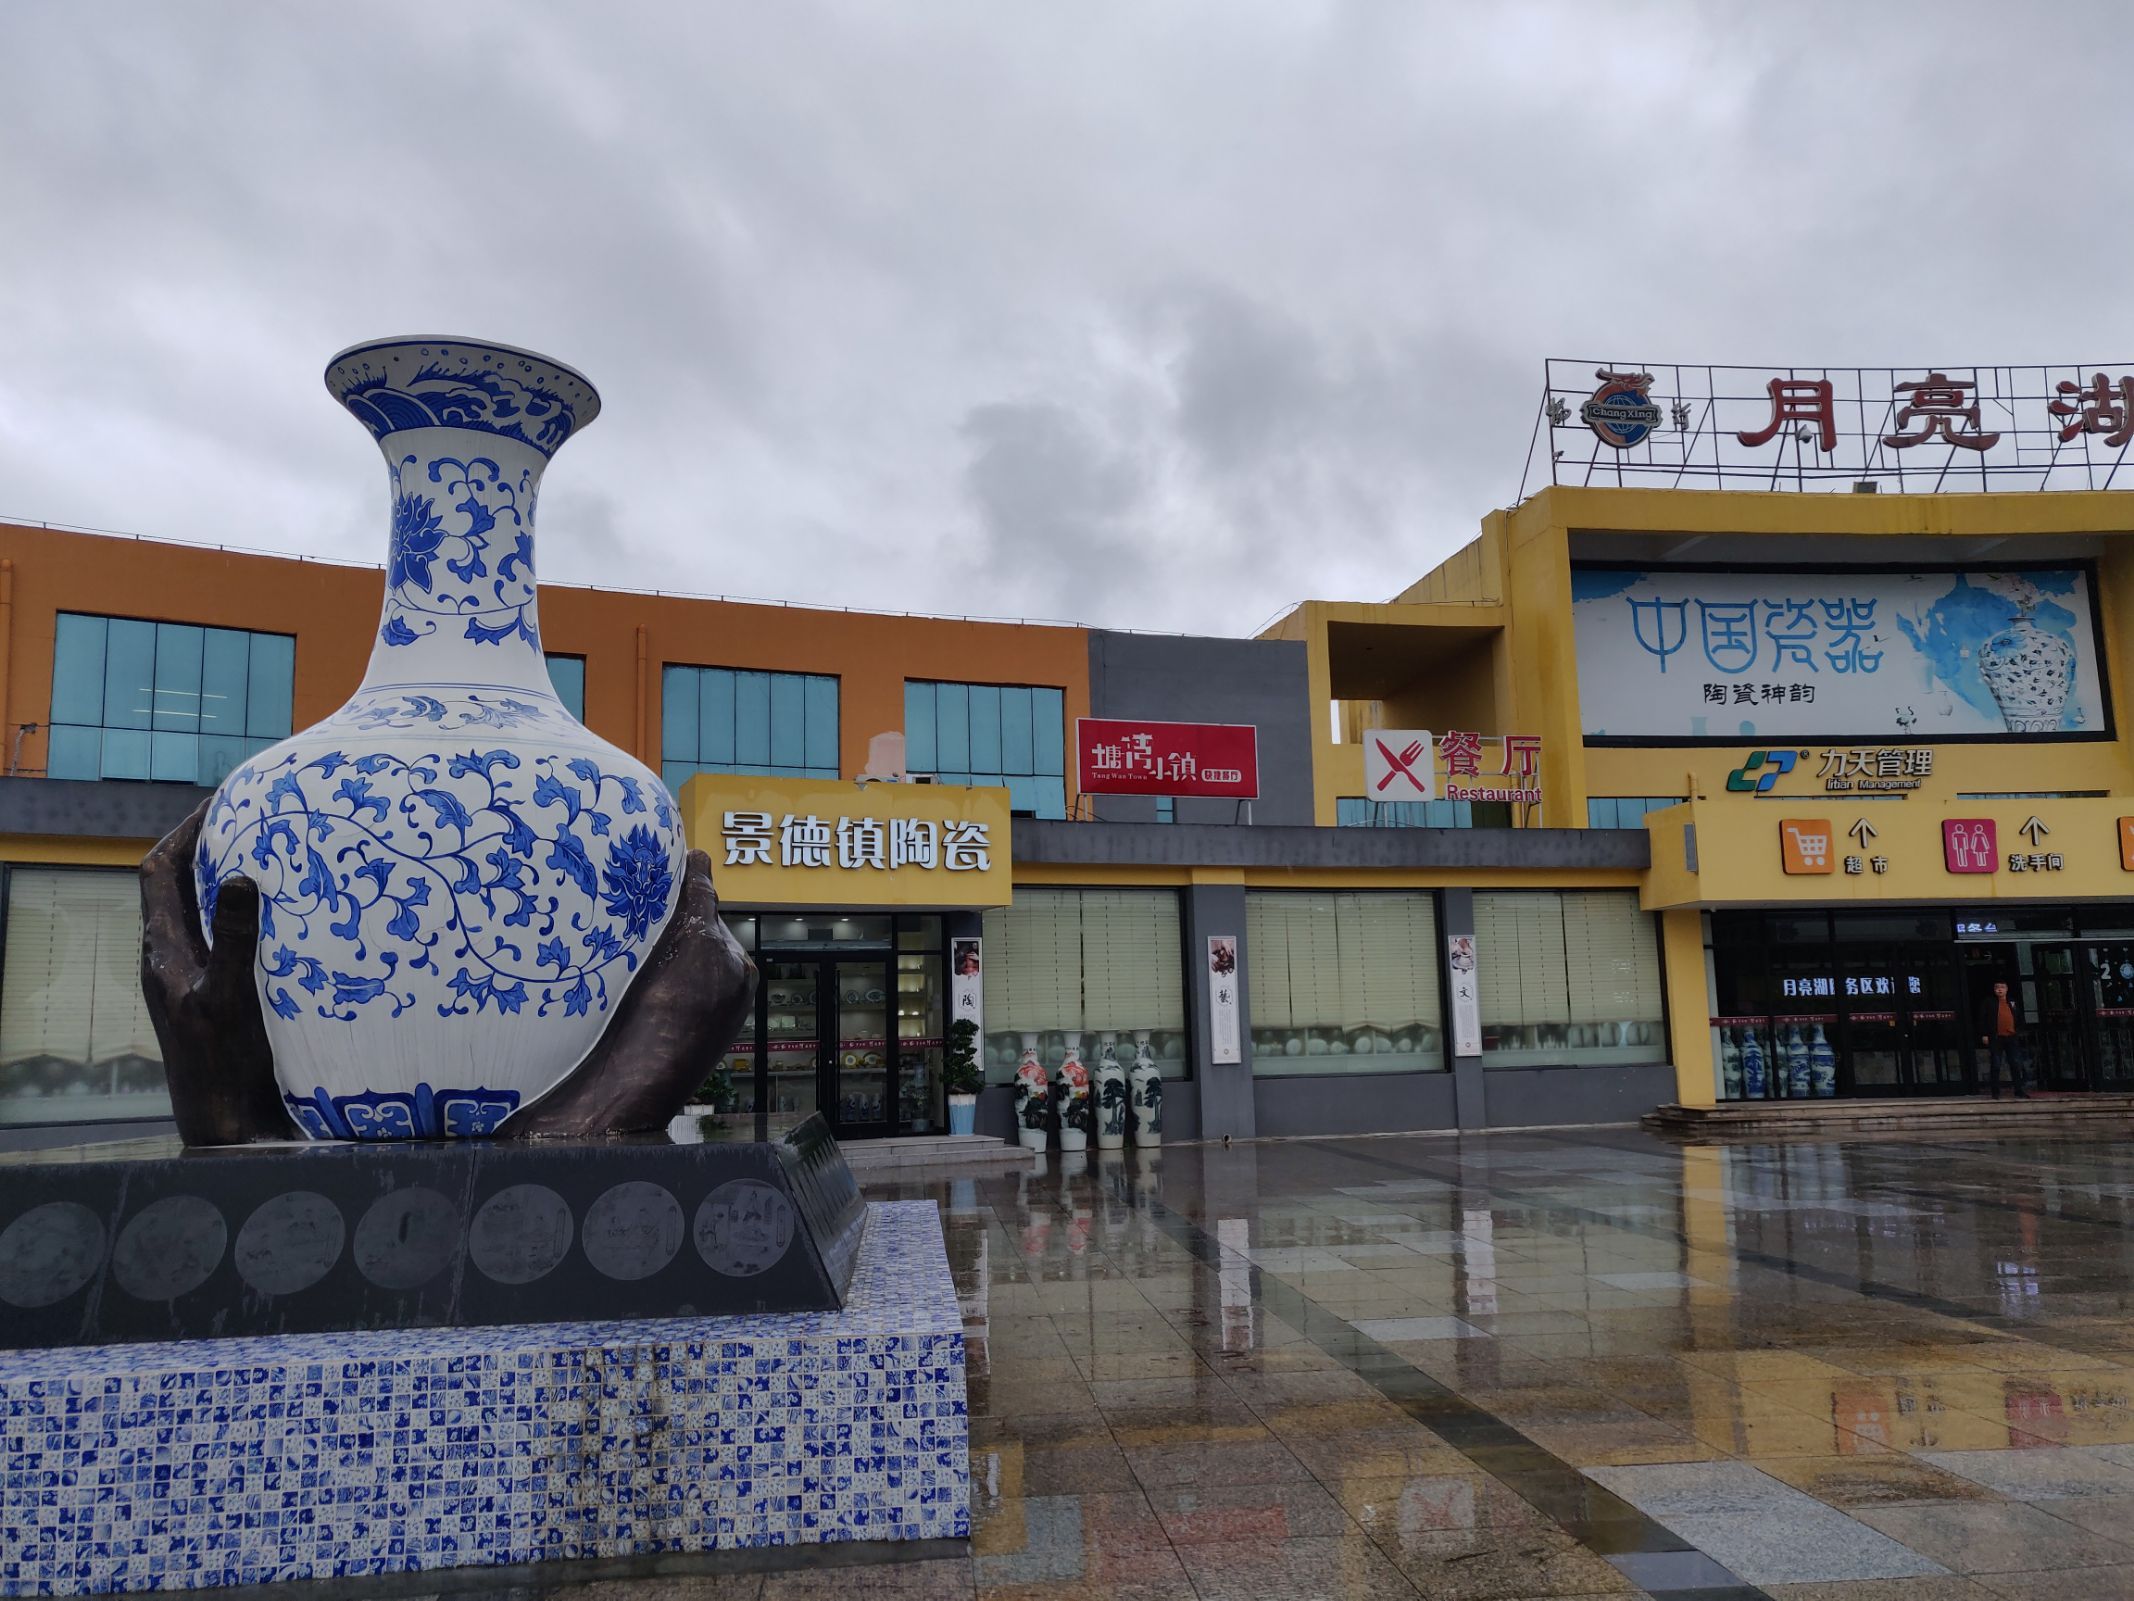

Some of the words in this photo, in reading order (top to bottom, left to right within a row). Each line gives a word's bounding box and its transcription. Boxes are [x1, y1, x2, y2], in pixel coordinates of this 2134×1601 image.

[1736, 373, 2133, 452] 月亮湖
[1626, 597, 1884, 674] 中国瓷器
[1703, 683, 1816, 706] 陶瓷神韵
[1091, 733, 1197, 781] 塘湾小镇
[1439, 730, 1541, 776] 餐厅
[1816, 749, 1934, 778] 力天管理
[1447, 784, 1542, 801] Restaurant
[1858, 778, 1921, 790] Management
[721, 811, 992, 872] 景德镇陶瓷
[1843, 856, 1888, 874] 超市
[2009, 854, 2064, 872] 洗手间
[1783, 976, 1922, 997] 月亮湖务区欢您
